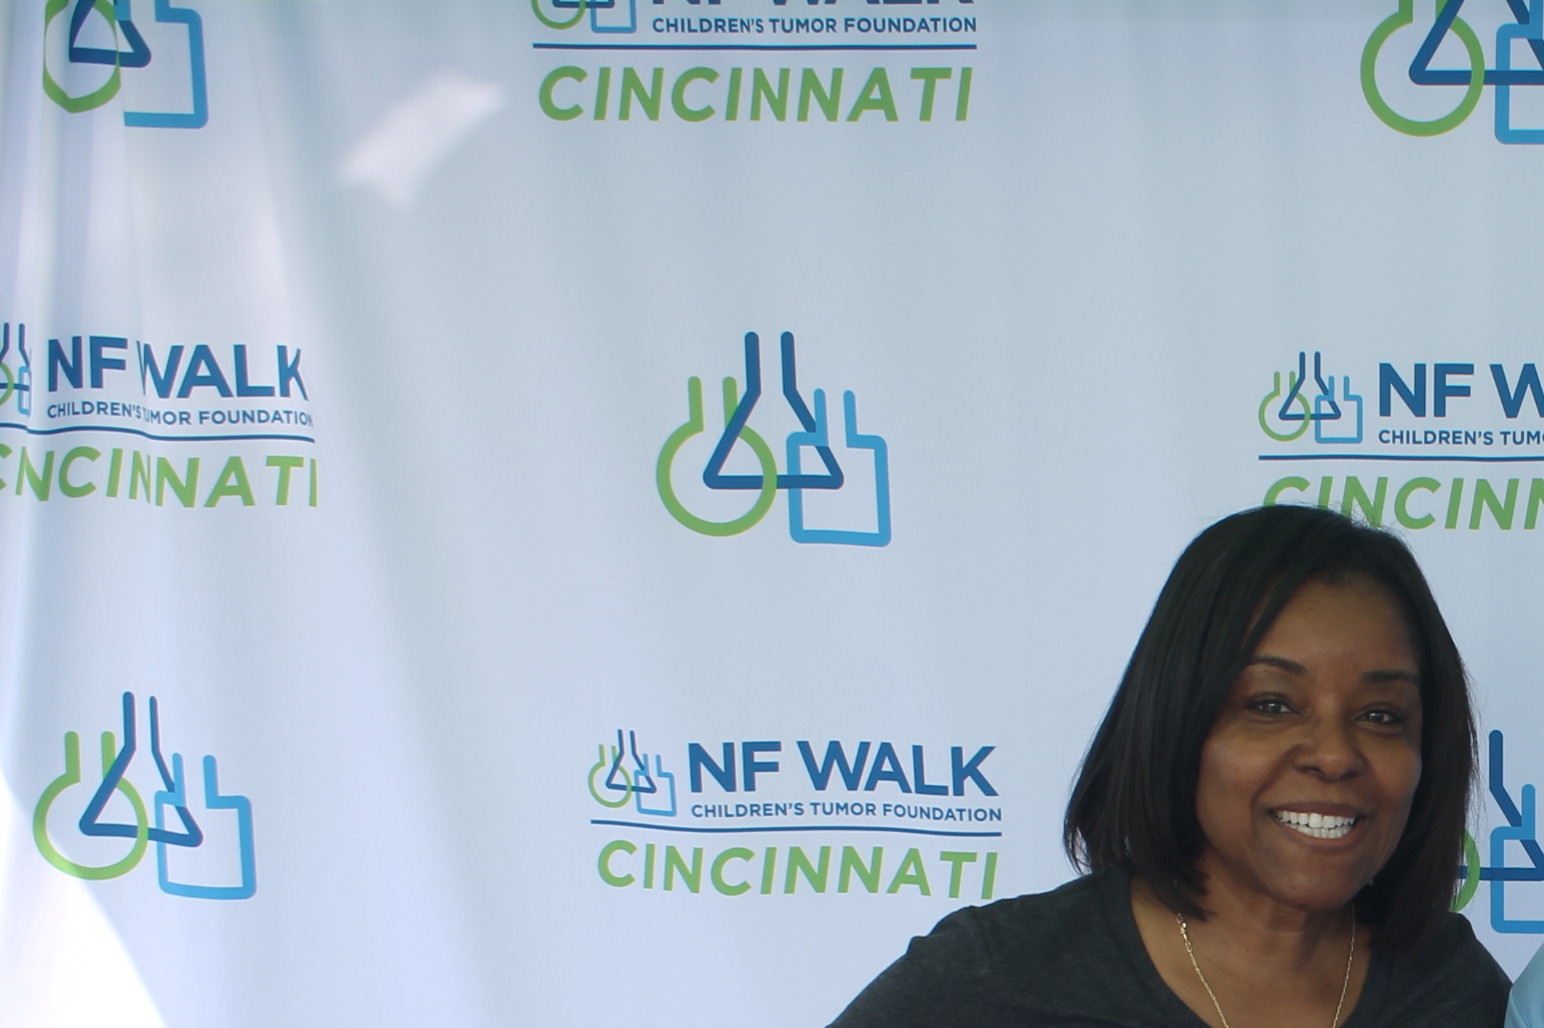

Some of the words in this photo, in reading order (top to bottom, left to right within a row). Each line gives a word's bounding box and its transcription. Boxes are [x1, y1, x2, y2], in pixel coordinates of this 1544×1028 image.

[652, 17, 765, 33] CHILDREN'S
[770, 17, 837, 33] TUMOR
[844, 17, 977, 33] FOUNDATION
[539, 65, 973, 122] CINCINNATI
[48, 336, 128, 392] NF
[136, 339, 310, 401] WALK
[1379, 363, 1474, 418] NF
[47, 401, 142, 419] CHILDREN'S
[199, 409, 314, 428] FOUNDATION
[1378, 429, 1494, 446] CHILDREN'S
[688, 741, 781, 793] NF
[797, 740, 999, 797] WALK
[691, 802, 804, 819] CHILDREN'S
[810, 802, 876, 817] TUMOR
[883, 803, 1002, 822] FOUNDATION
[597, 839, 998, 900] CINCINNATI
